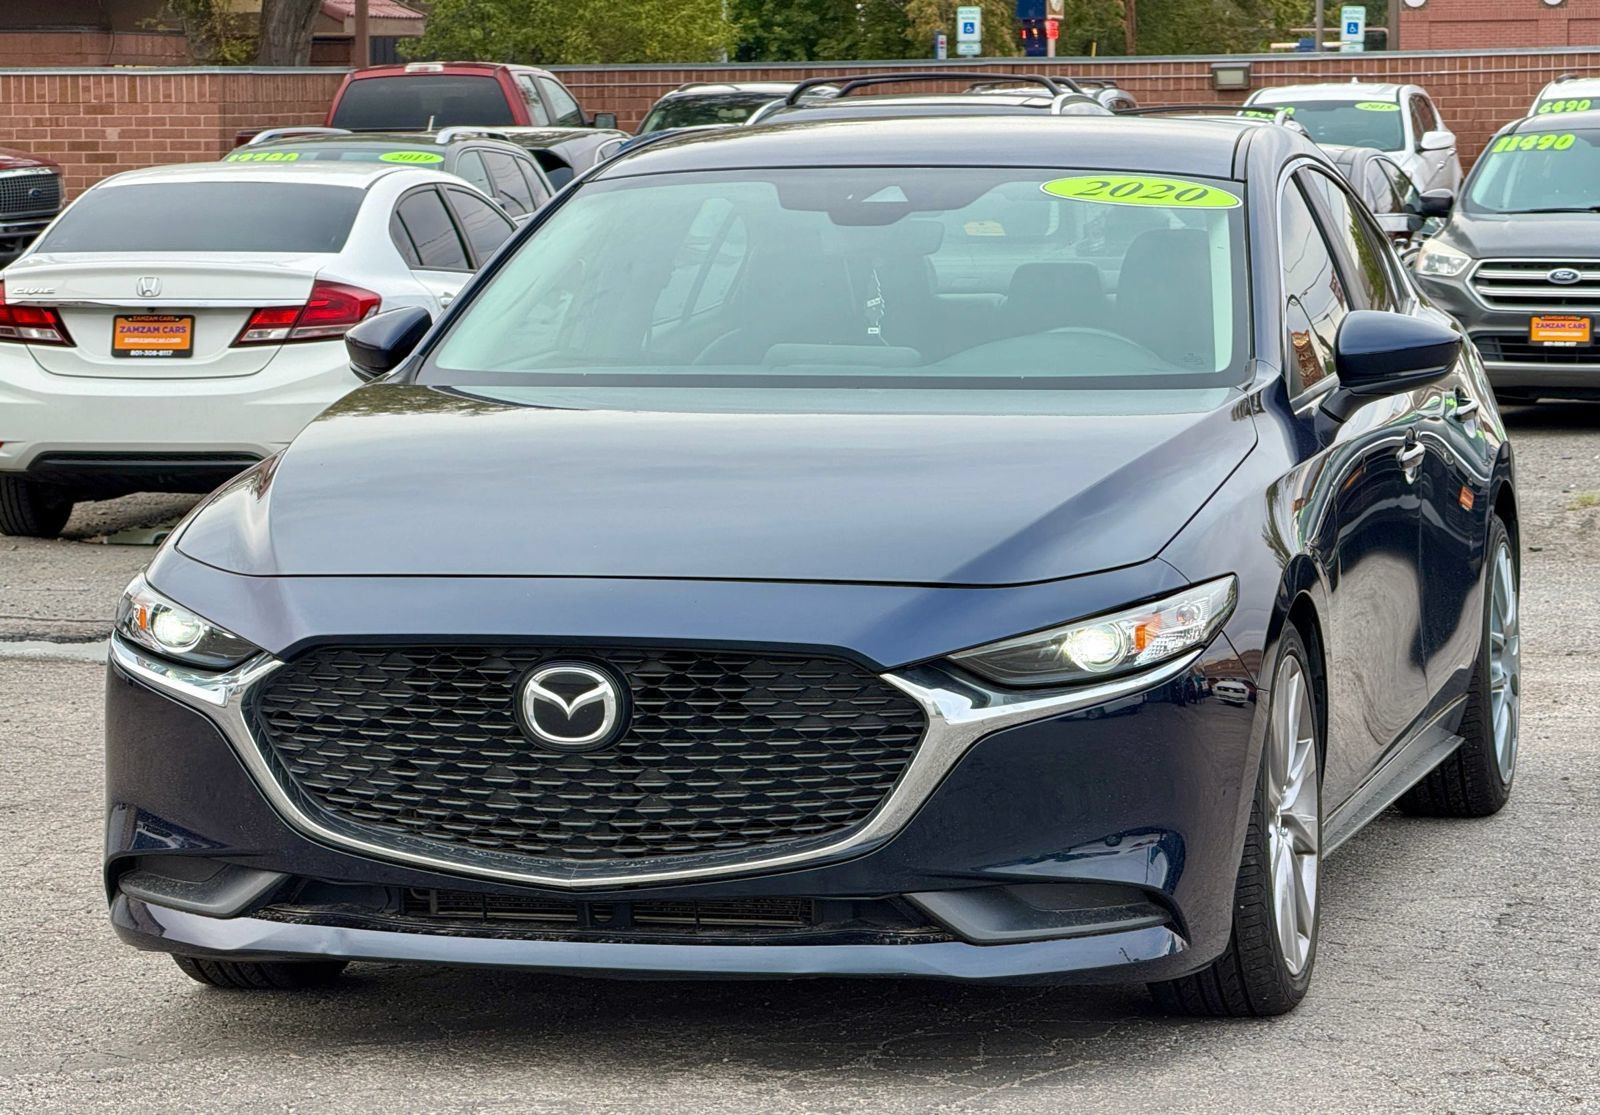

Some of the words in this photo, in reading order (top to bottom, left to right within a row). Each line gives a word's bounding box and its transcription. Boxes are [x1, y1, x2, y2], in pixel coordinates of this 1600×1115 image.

[1492, 133, 1576, 153] 11490
[1073, 180, 1210, 202] 2020
[120, 326, 160, 334] ZAMZAM
[162, 326, 186, 334] CARS
